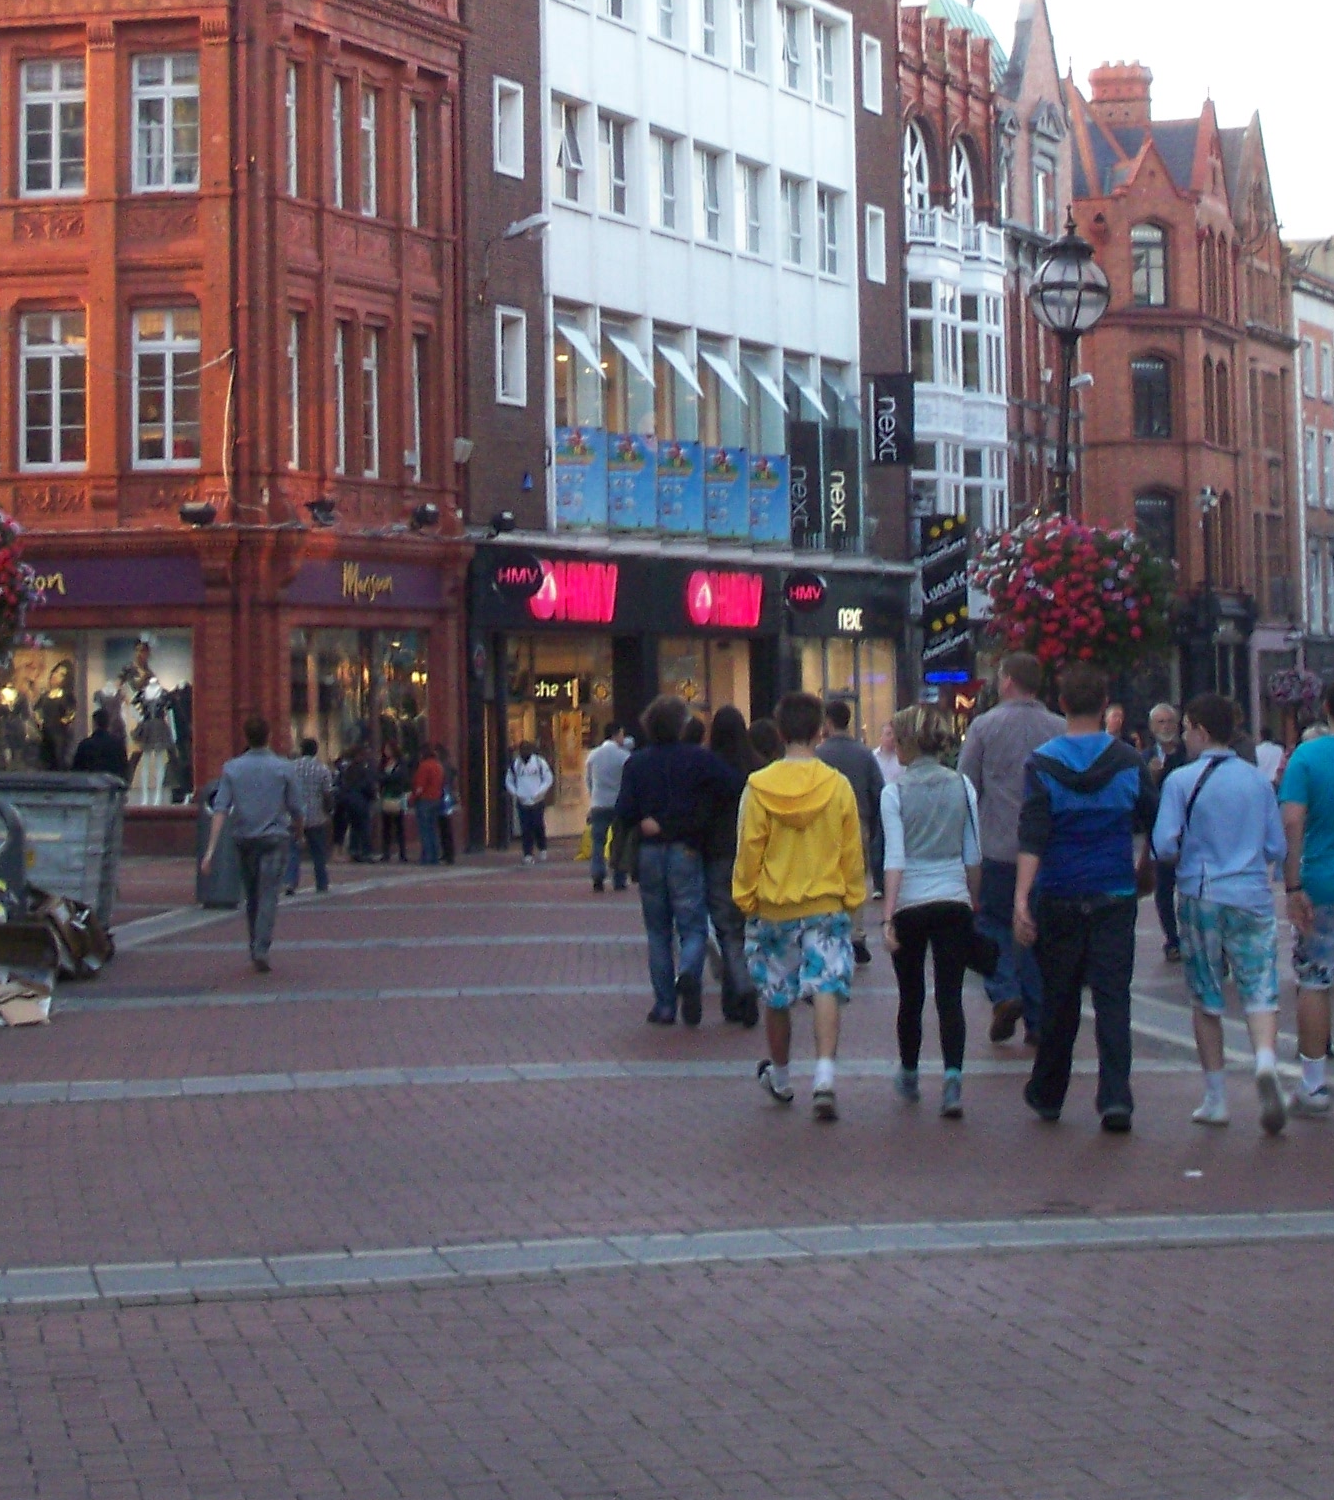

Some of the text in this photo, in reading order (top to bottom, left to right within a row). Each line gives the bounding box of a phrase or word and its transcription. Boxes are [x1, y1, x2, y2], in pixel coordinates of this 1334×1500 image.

[878, 396, 899, 463] next
[830, 470, 846, 534] next
[498, 567, 540, 585] HMV
[555, 561, 618, 623] HMV
[710, 570, 763, 628] HMV
[789, 586, 822, 601] HMV
[838, 607, 865, 632] next
